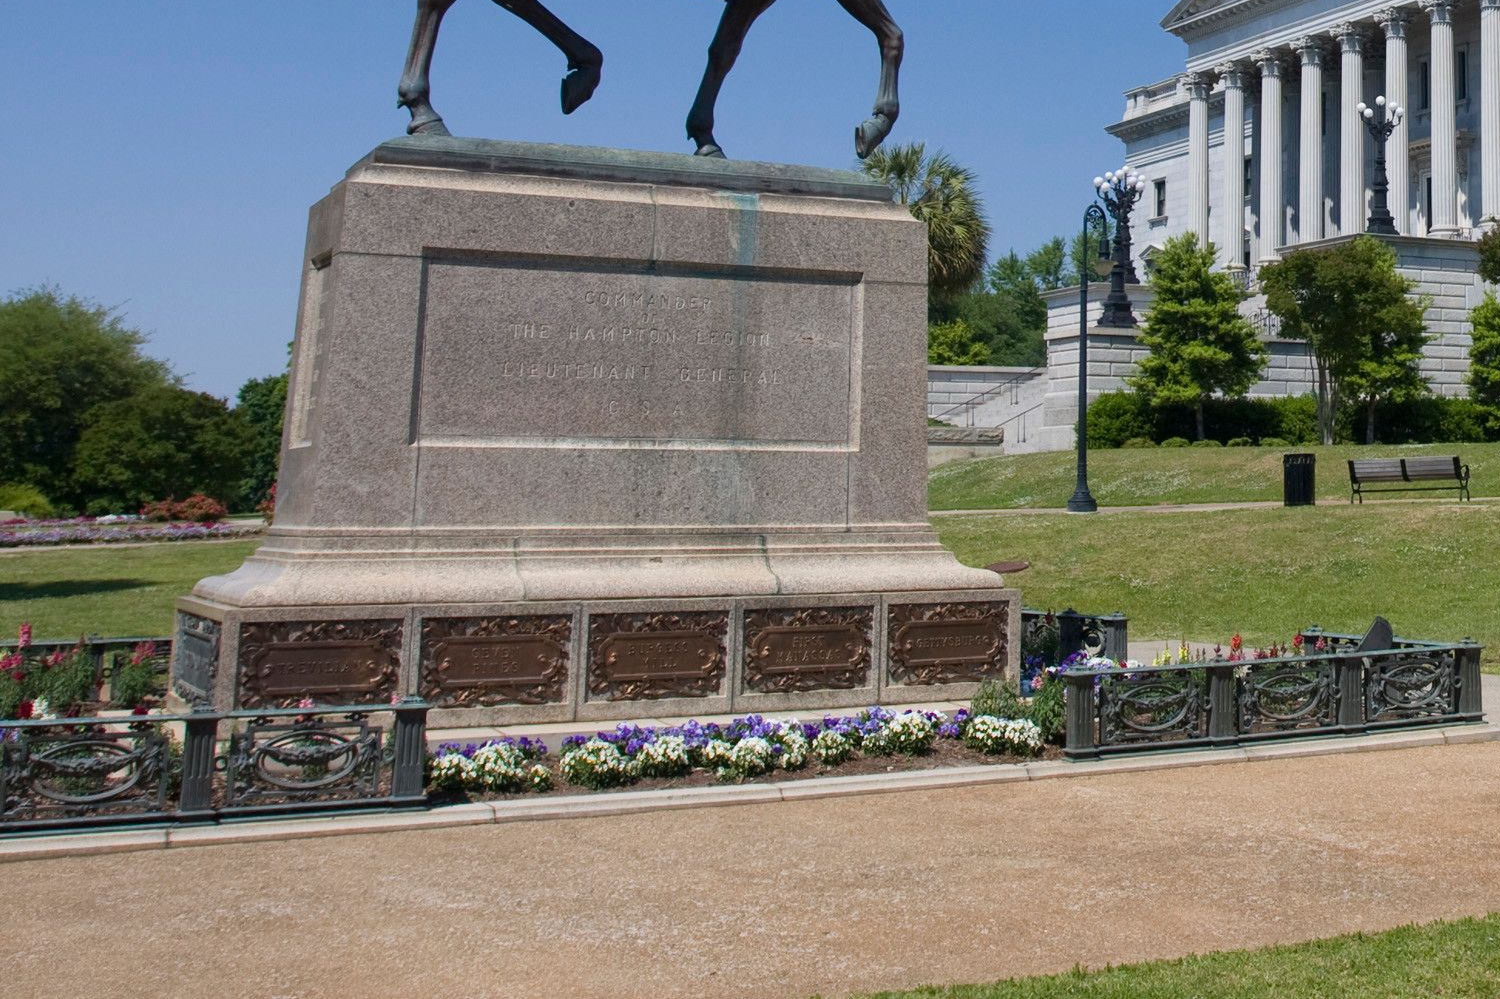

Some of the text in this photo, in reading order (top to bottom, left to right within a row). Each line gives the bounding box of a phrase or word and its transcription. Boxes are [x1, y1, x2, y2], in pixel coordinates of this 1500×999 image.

[584, 290, 713, 311] COMMANDER
[511, 323, 771, 348] THE HAMPTON LEGION
[502, 361, 784, 386] LIEUTENANT GENERAL
[914, 634, 981, 649] GETTYSBURG
[471, 646, 521, 660] SEVEN
[472, 661, 519, 675] PINES
